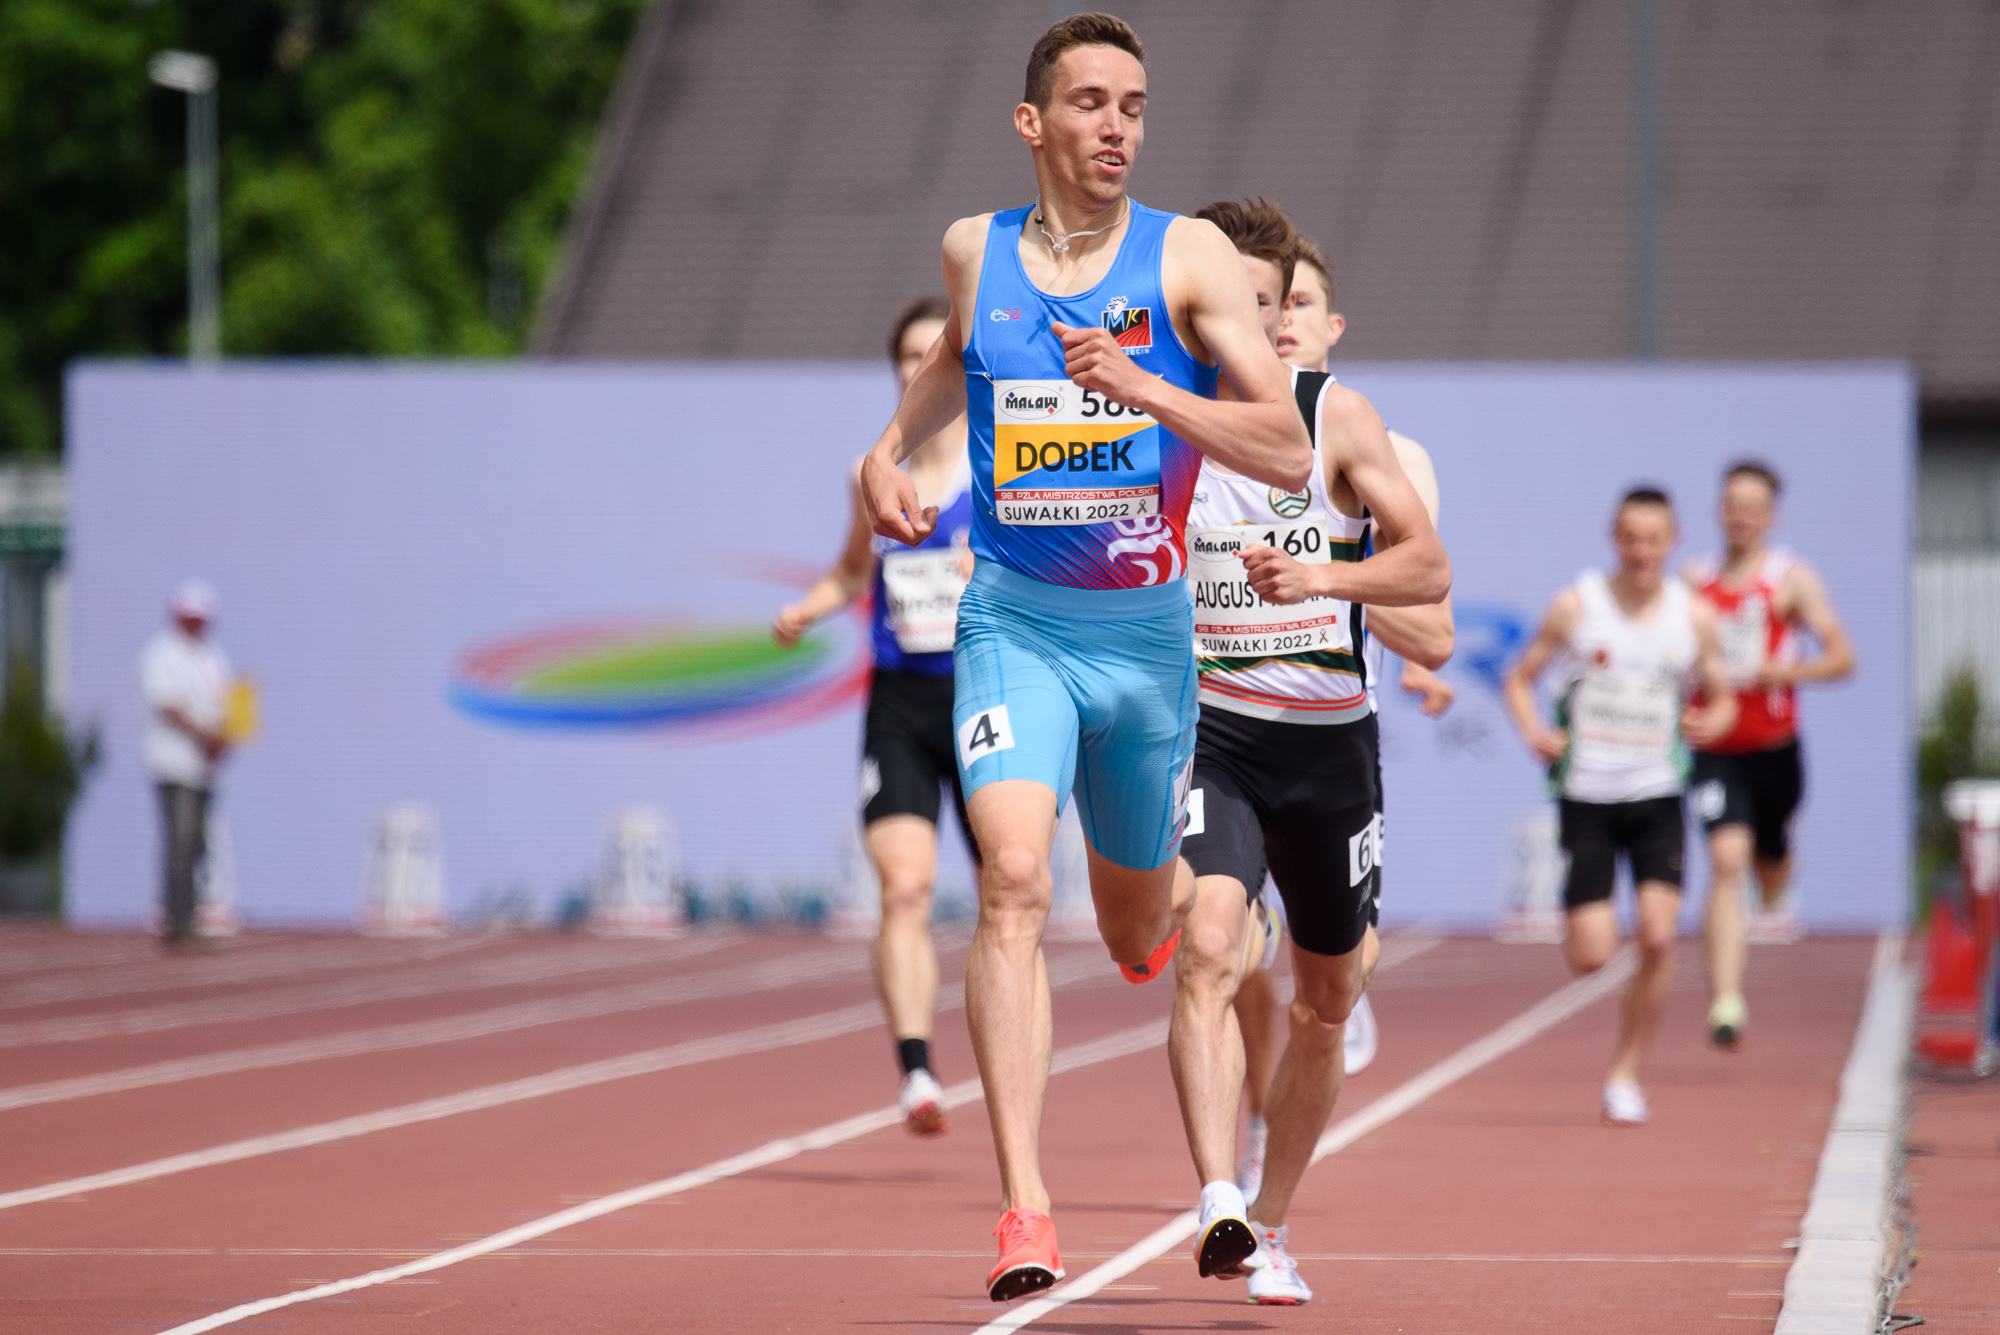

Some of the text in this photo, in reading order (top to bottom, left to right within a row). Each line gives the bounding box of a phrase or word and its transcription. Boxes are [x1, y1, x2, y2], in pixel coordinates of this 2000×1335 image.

[991, 308, 1020, 321] esa
[1124, 348, 1150, 356] ZECIN
[1015, 440, 1135, 472] DOBEK
[1017, 492, 1041, 500] PZLA
[1043, 490, 1116, 500] MISTRZOSTWA
[1118, 488, 1154, 497] POLSKI
[1004, 504, 1129, 520] SUWAŁKI 2022
[1263, 526, 1321, 556] 160
[1211, 626, 1231, 634] PZLA
[1233, 622, 1300, 634] MISTRZOSTWA
[1301, 616, 1332, 628] POLSKI
[1202, 634, 1312, 653] SUWAŁKI 2022
[969, 713, 1000, 752] 4
[1359, 830, 1370, 873] 6
